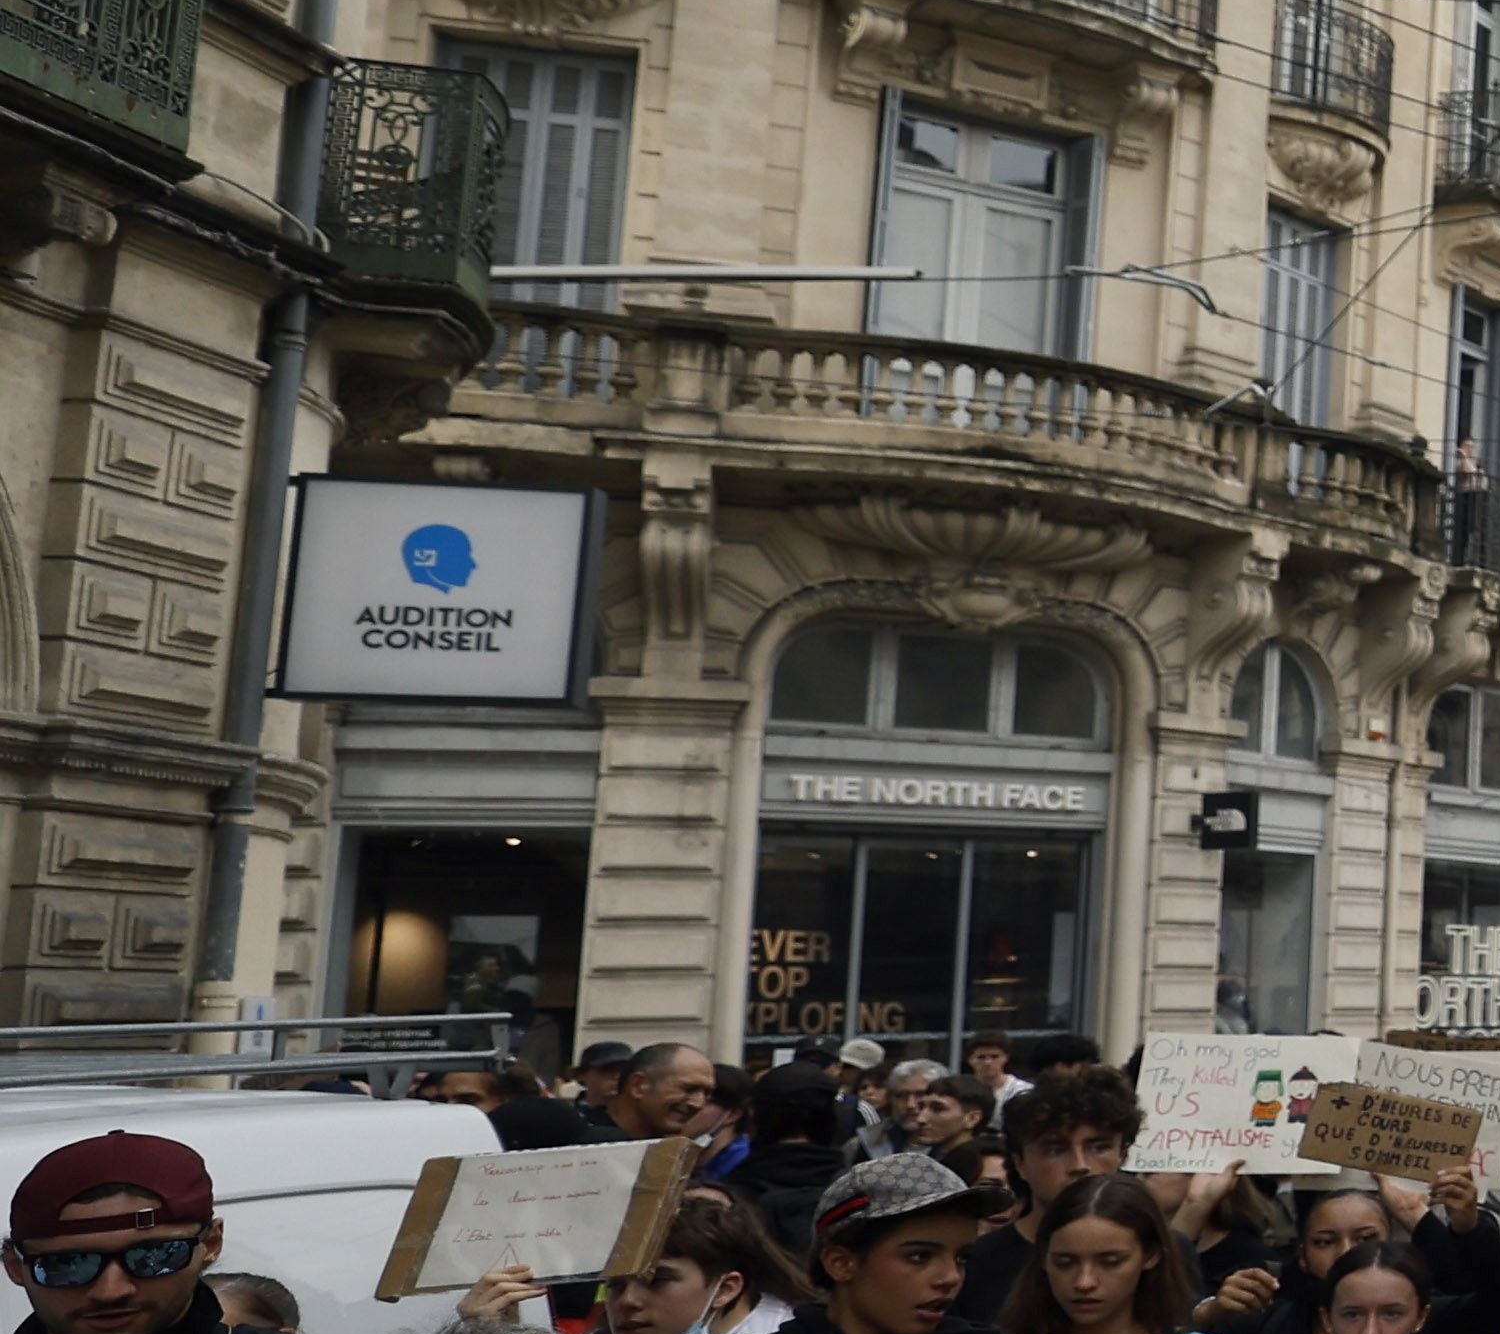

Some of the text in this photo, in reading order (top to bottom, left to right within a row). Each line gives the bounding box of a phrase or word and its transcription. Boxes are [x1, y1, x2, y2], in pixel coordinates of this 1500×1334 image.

[355, 605, 514, 628] AUDITION
[361, 629, 501, 652] CONSEIL
[789, 773, 1087, 811] THE NORTH FACE
[1149, 1038, 1188, 1062] Oh
[1243, 1041, 1283, 1071] god
[1149, 1066, 1189, 1097] They
[1374, 1051, 1445, 1088] NOUS
[1357, 1111, 1412, 1134] COURS
[1361, 1093, 1444, 1125] D'HEURES
[1450, 1109, 1473, 1130] DE
[1314, 1122, 1356, 1144] QUE
[1347, 1145, 1431, 1171] SOMMEIL
